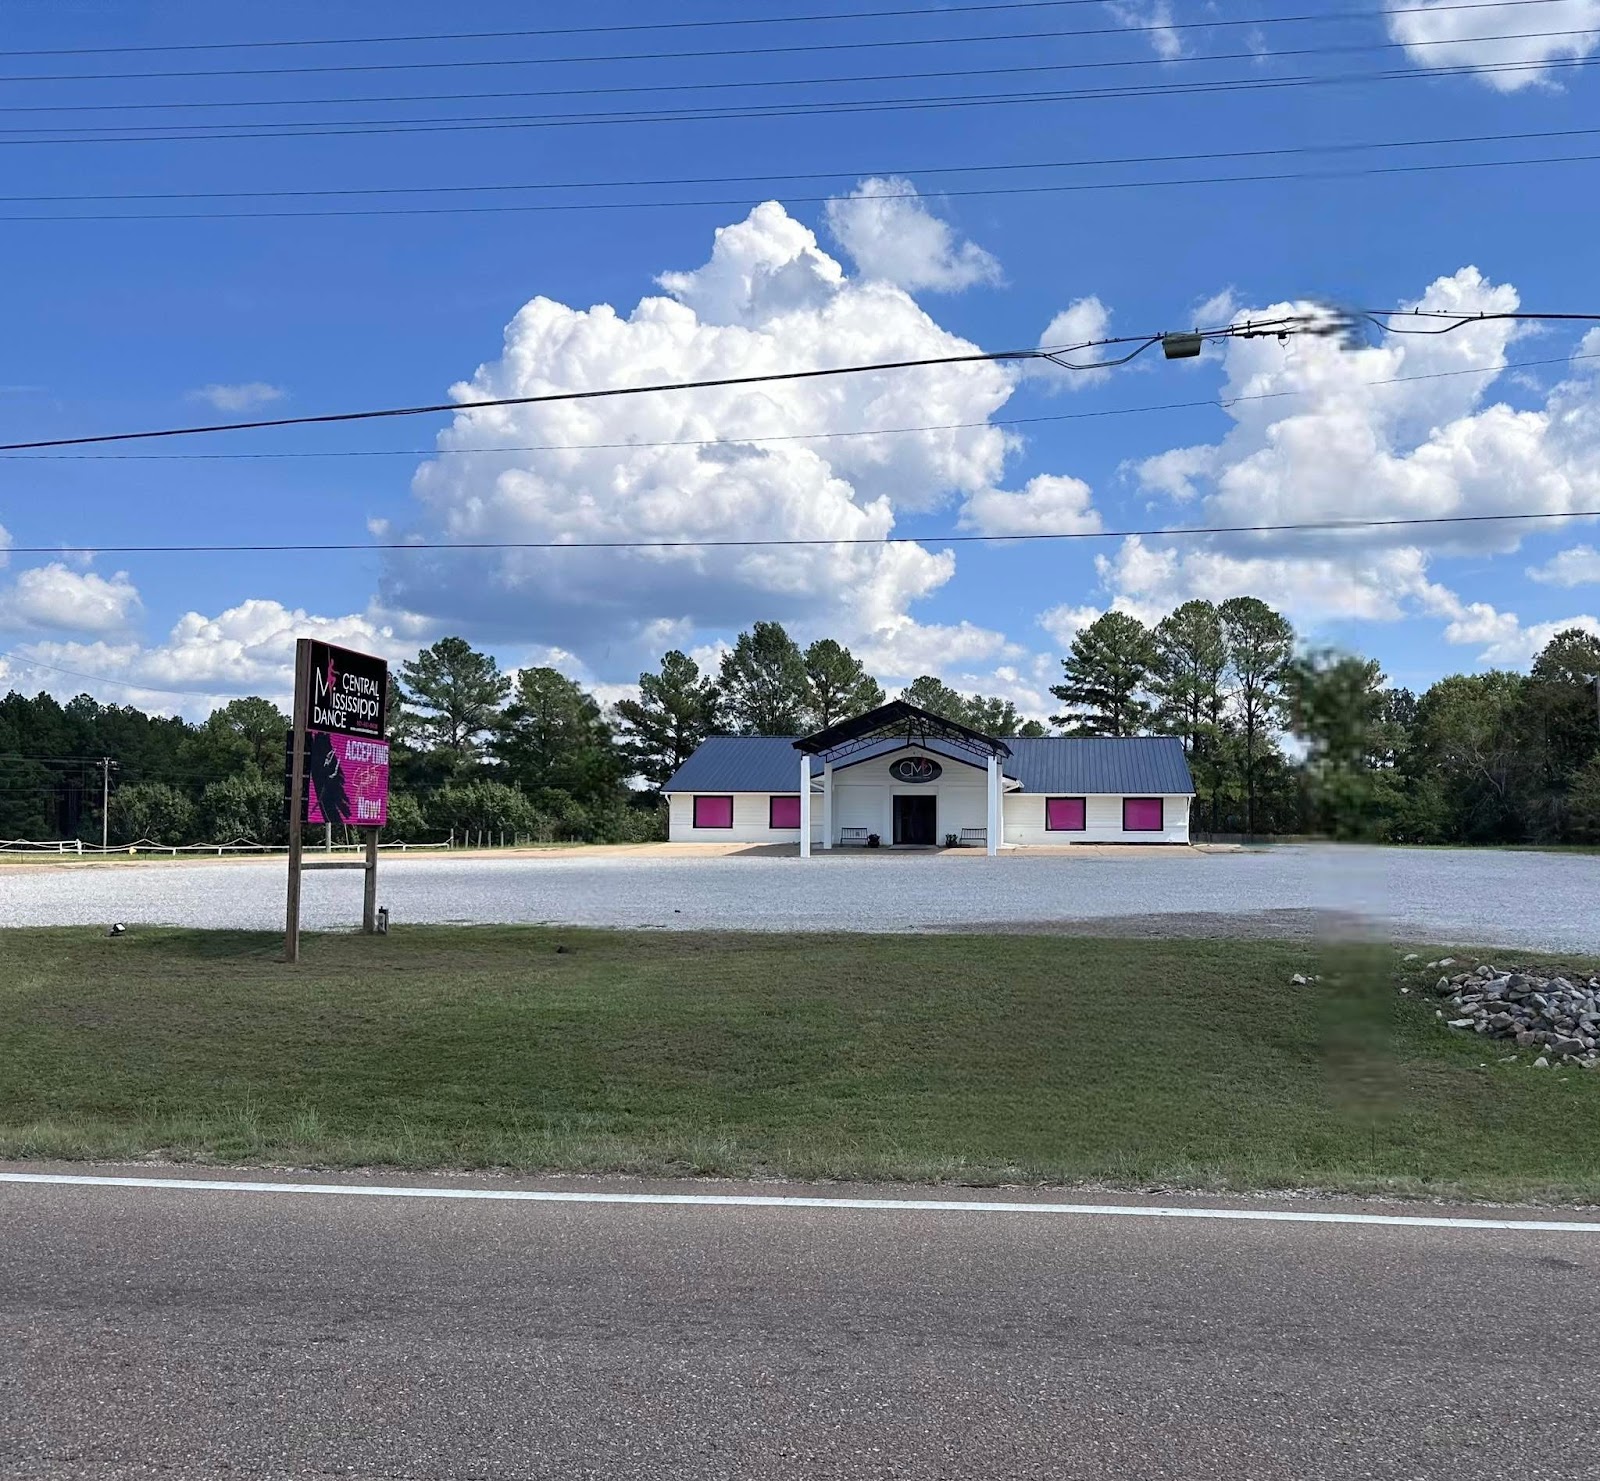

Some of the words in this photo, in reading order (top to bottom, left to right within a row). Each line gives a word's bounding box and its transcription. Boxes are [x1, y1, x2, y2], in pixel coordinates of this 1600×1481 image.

[342, 673, 379, 696] CENTRAL
[314, 706, 347, 728] DANCE
[345, 740, 389, 765] ACCEPTING
